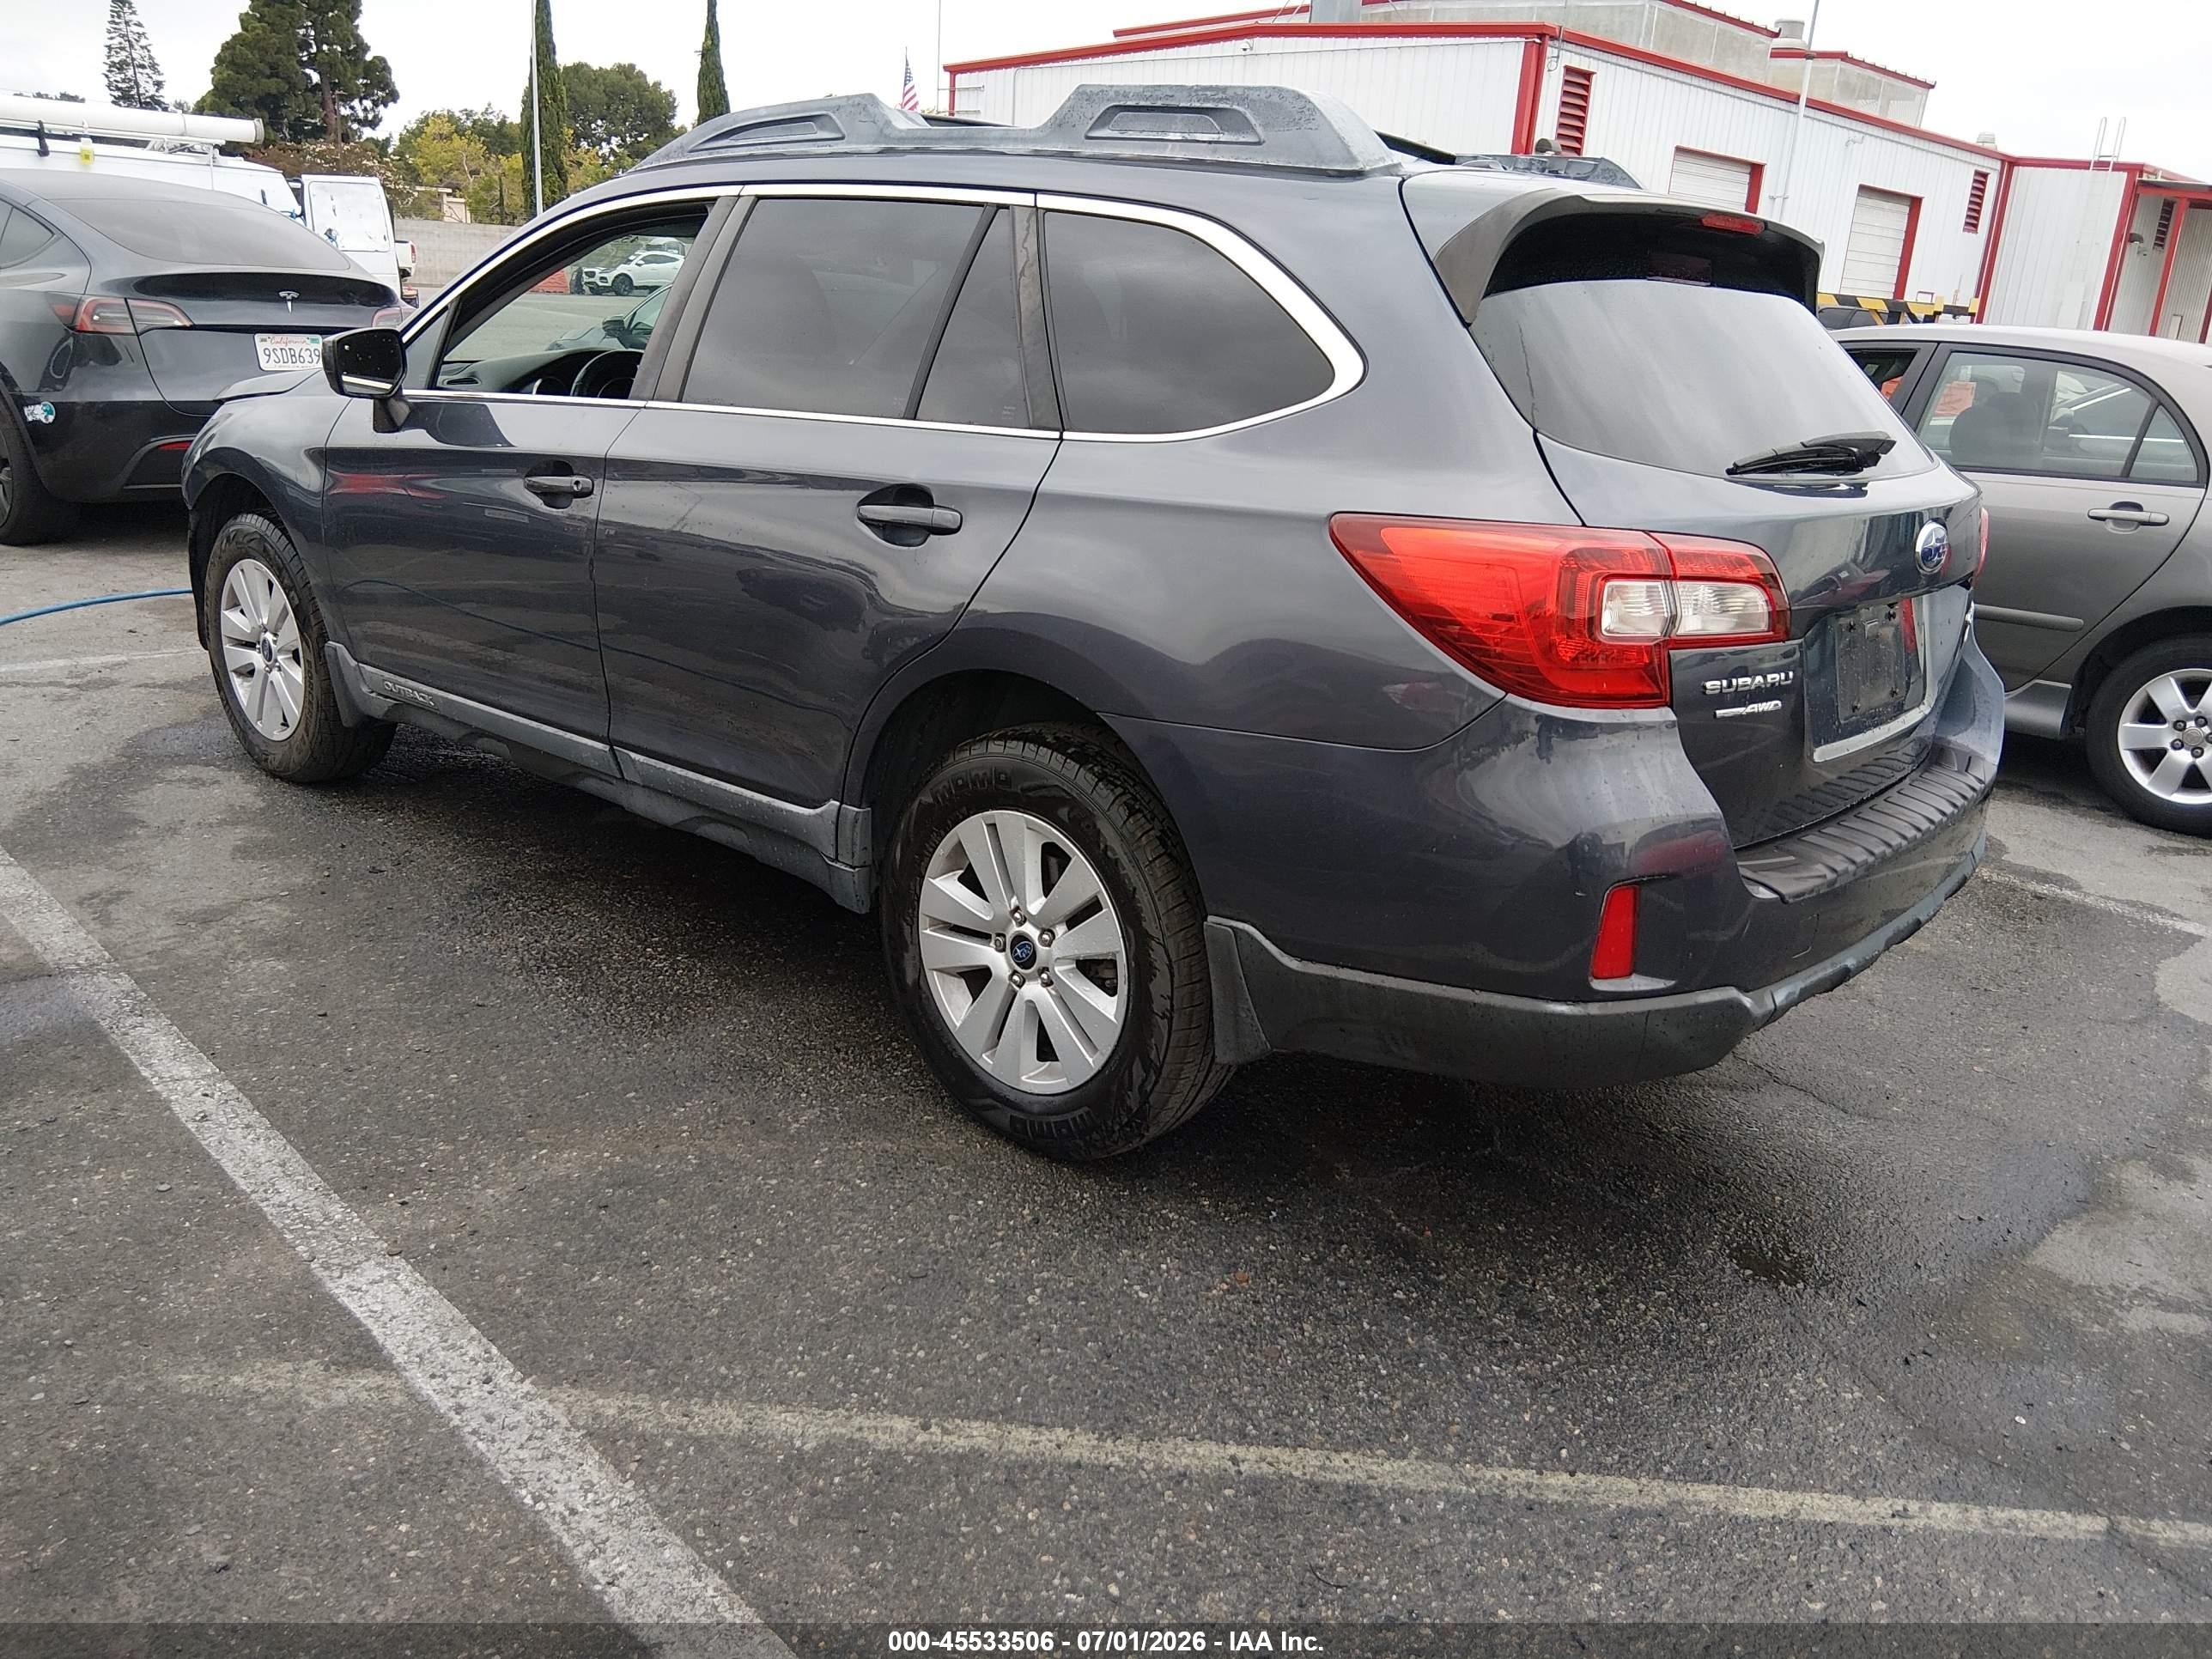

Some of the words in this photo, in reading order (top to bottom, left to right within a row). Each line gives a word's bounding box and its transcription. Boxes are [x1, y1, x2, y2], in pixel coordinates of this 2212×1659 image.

[263, 347, 321, 365] 9SDB639
[384, 681, 434, 706] OUTBACK
[1704, 671, 1794, 695] SUBARU
[1741, 700, 1783, 714] AWD
